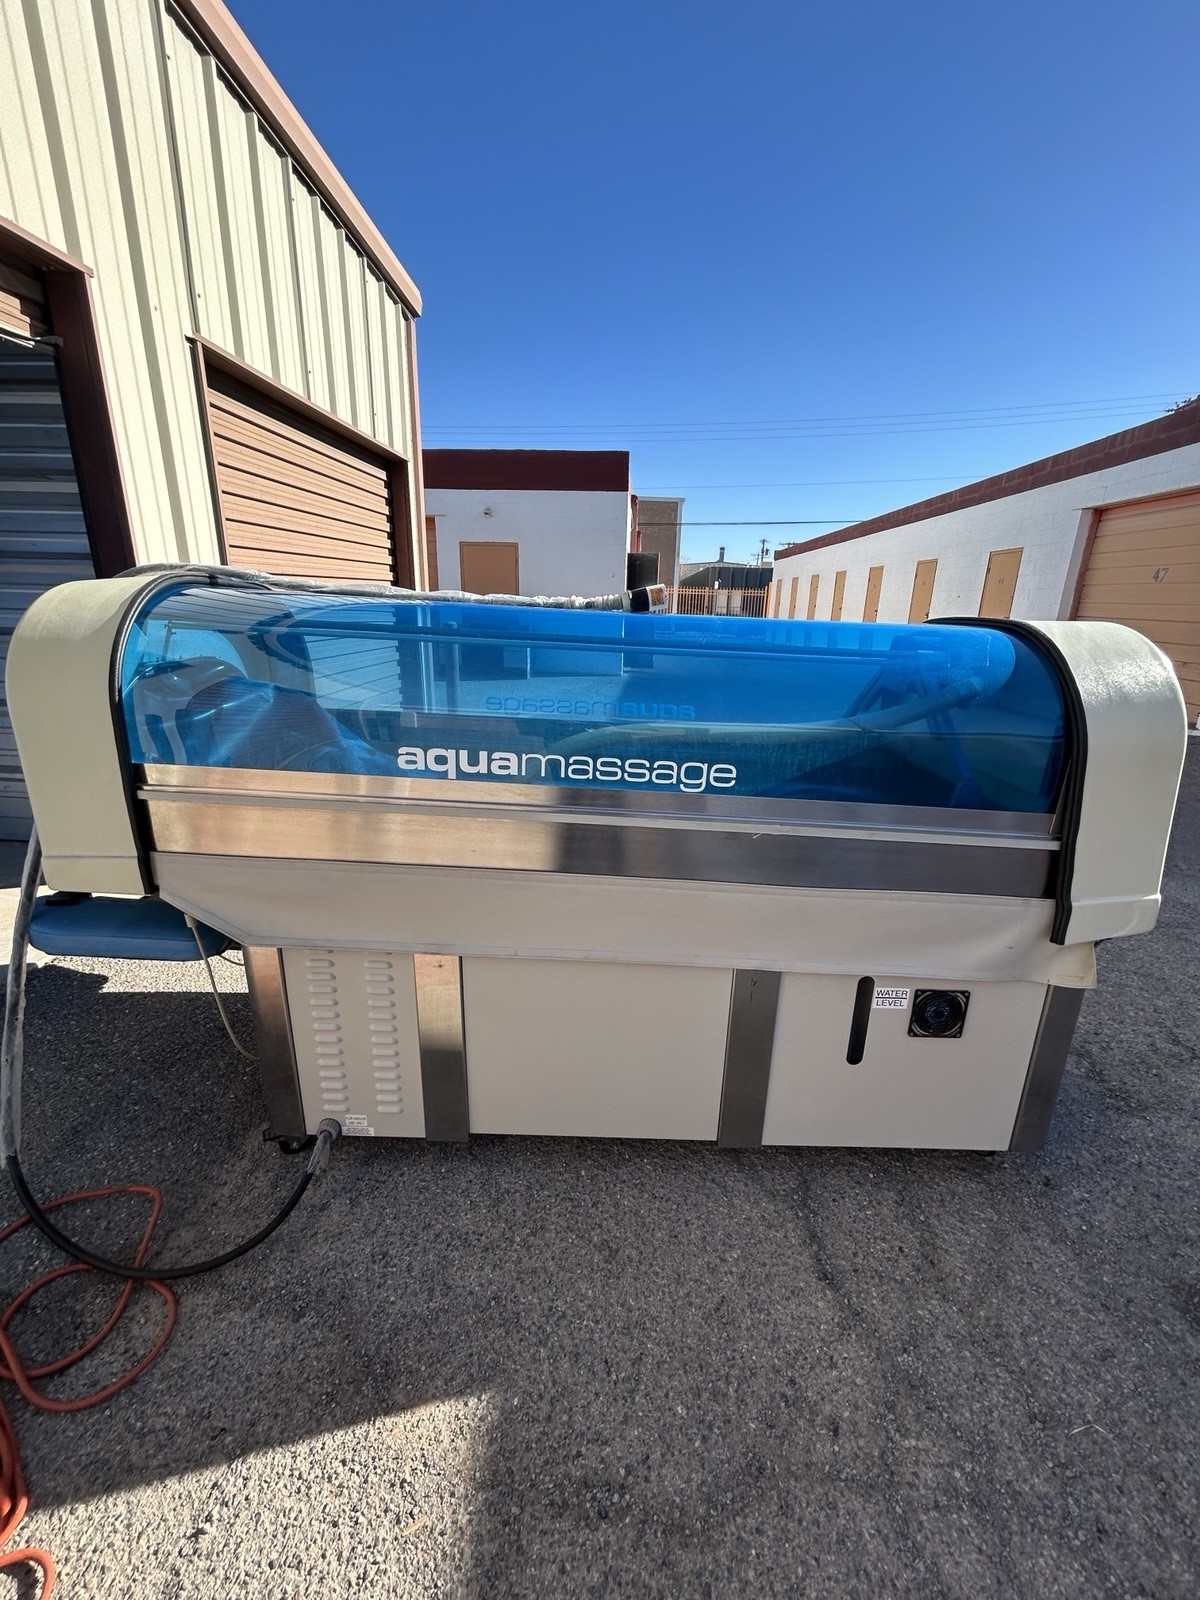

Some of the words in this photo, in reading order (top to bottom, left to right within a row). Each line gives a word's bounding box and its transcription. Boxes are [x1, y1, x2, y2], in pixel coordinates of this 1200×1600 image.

[1152, 567, 1169, 582] 47
[397, 746, 737, 792] aquamassage
[876, 989, 908, 997] WATER
[876, 999, 904, 1007] LEVEL
